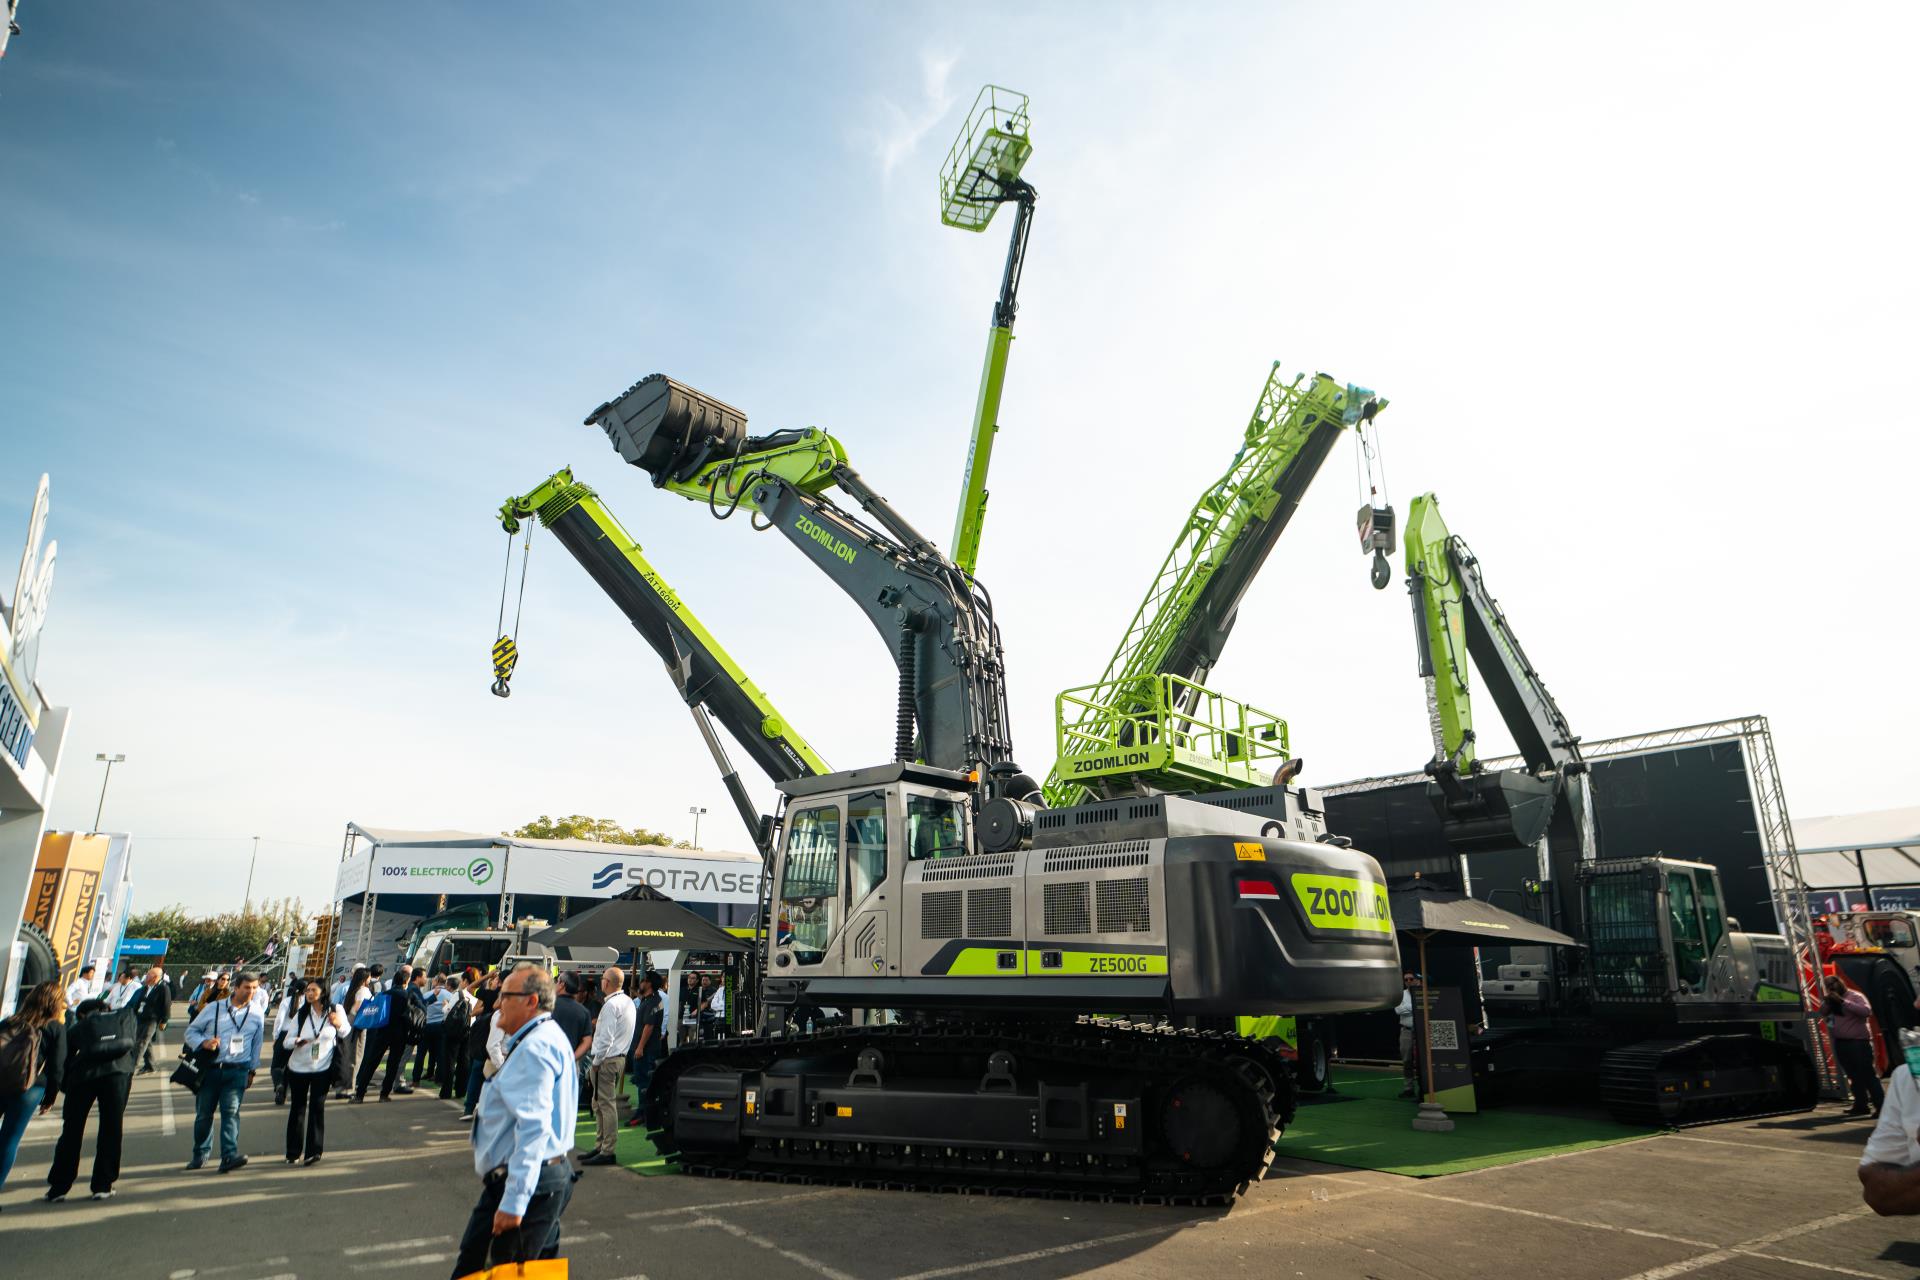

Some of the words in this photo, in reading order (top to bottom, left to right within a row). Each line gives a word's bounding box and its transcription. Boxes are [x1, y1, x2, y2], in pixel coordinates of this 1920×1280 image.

[795, 514, 857, 564] ZOOMLION
[643, 571, 679, 611] ZAT1600H
[1074, 752, 1150, 773] ZOOMLION
[382, 867, 407, 876] 100%
[410, 867, 466, 876] ELECTRICO
[35, 872, 57, 928] ANCE
[1306, 886, 1390, 921] ZOOMLION
[627, 929, 684, 938] ZOOMLION
[1089, 957, 1147, 973] ZE500G
[725, 975, 733, 1025] ZOOMLION
